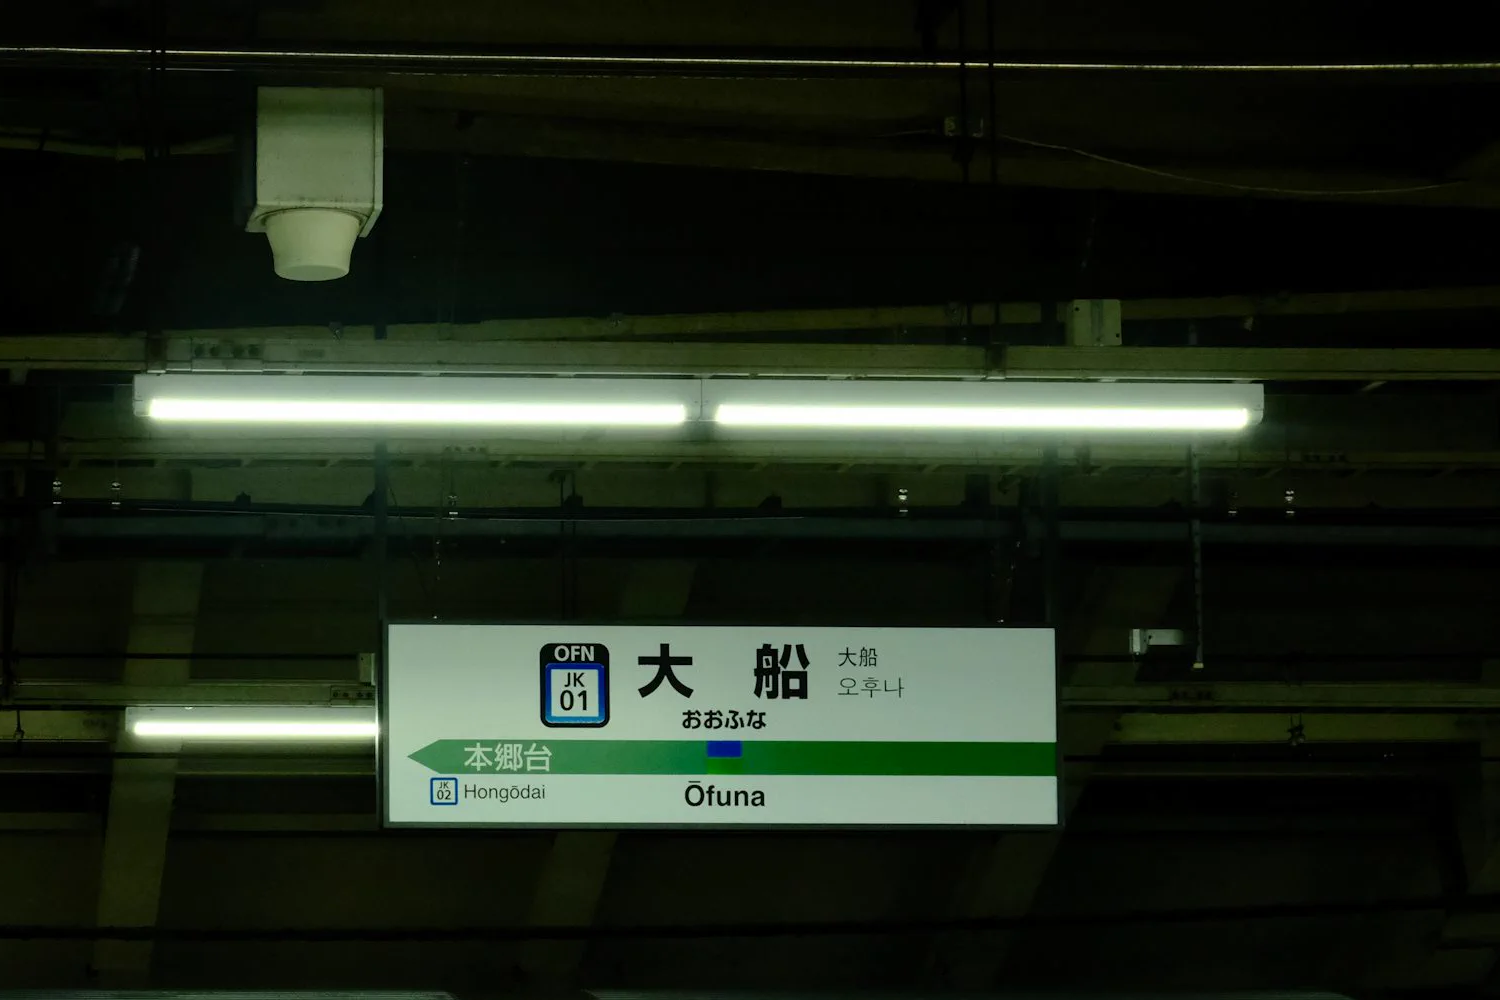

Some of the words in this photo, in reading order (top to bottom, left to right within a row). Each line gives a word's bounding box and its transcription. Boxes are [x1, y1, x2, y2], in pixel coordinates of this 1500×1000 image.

[553, 644, 596, 663] OFN
[838, 645, 879, 668] 大船
[564, 672, 586, 688] JK
[838, 677, 906, 699] 오후나
[558, 689, 589, 712] 01
[681, 708, 768, 731] おおふな
[463, 743, 553, 773] 本郷台
[436, 789, 452, 801] 02
[438, 781, 450, 789] JK
[463, 784, 547, 803] Hongōdai
[683, 780, 766, 808] Ōfuna
